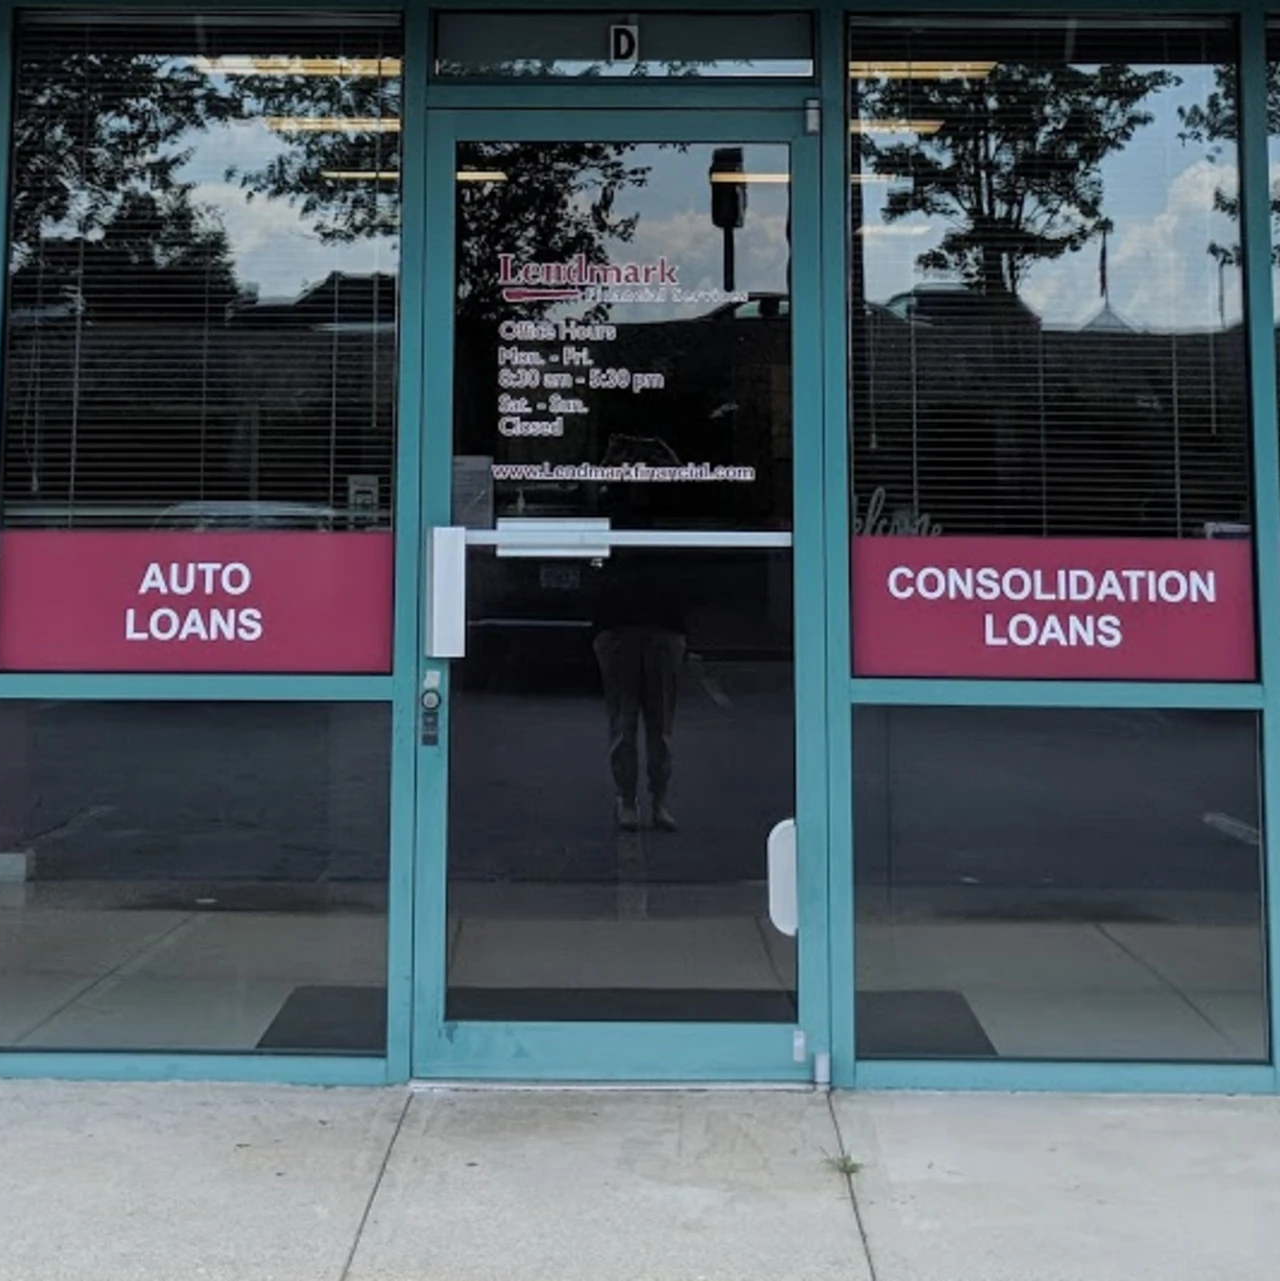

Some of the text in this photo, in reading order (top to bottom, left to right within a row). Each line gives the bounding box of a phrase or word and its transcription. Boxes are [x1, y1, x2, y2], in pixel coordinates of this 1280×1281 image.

[613, 28, 637, 60] D
[497, 253, 680, 286] Lendmark
[498, 320, 617, 341] Office Hours
[498, 367, 541, 389] 8:30
[543, 373, 574, 389] am
[588, 367, 631, 389] 5:30
[632, 373, 665, 394] pm
[498, 393, 533, 414] Sat.
[548, 392, 589, 414] Sun.
[498, 416, 564, 437] Closed
[138, 561, 252, 596] AUTO
[887, 566, 1217, 603] CONSOLIDATION
[124, 607, 264, 642] LOANS
[984, 613, 1123, 648] LOANS
